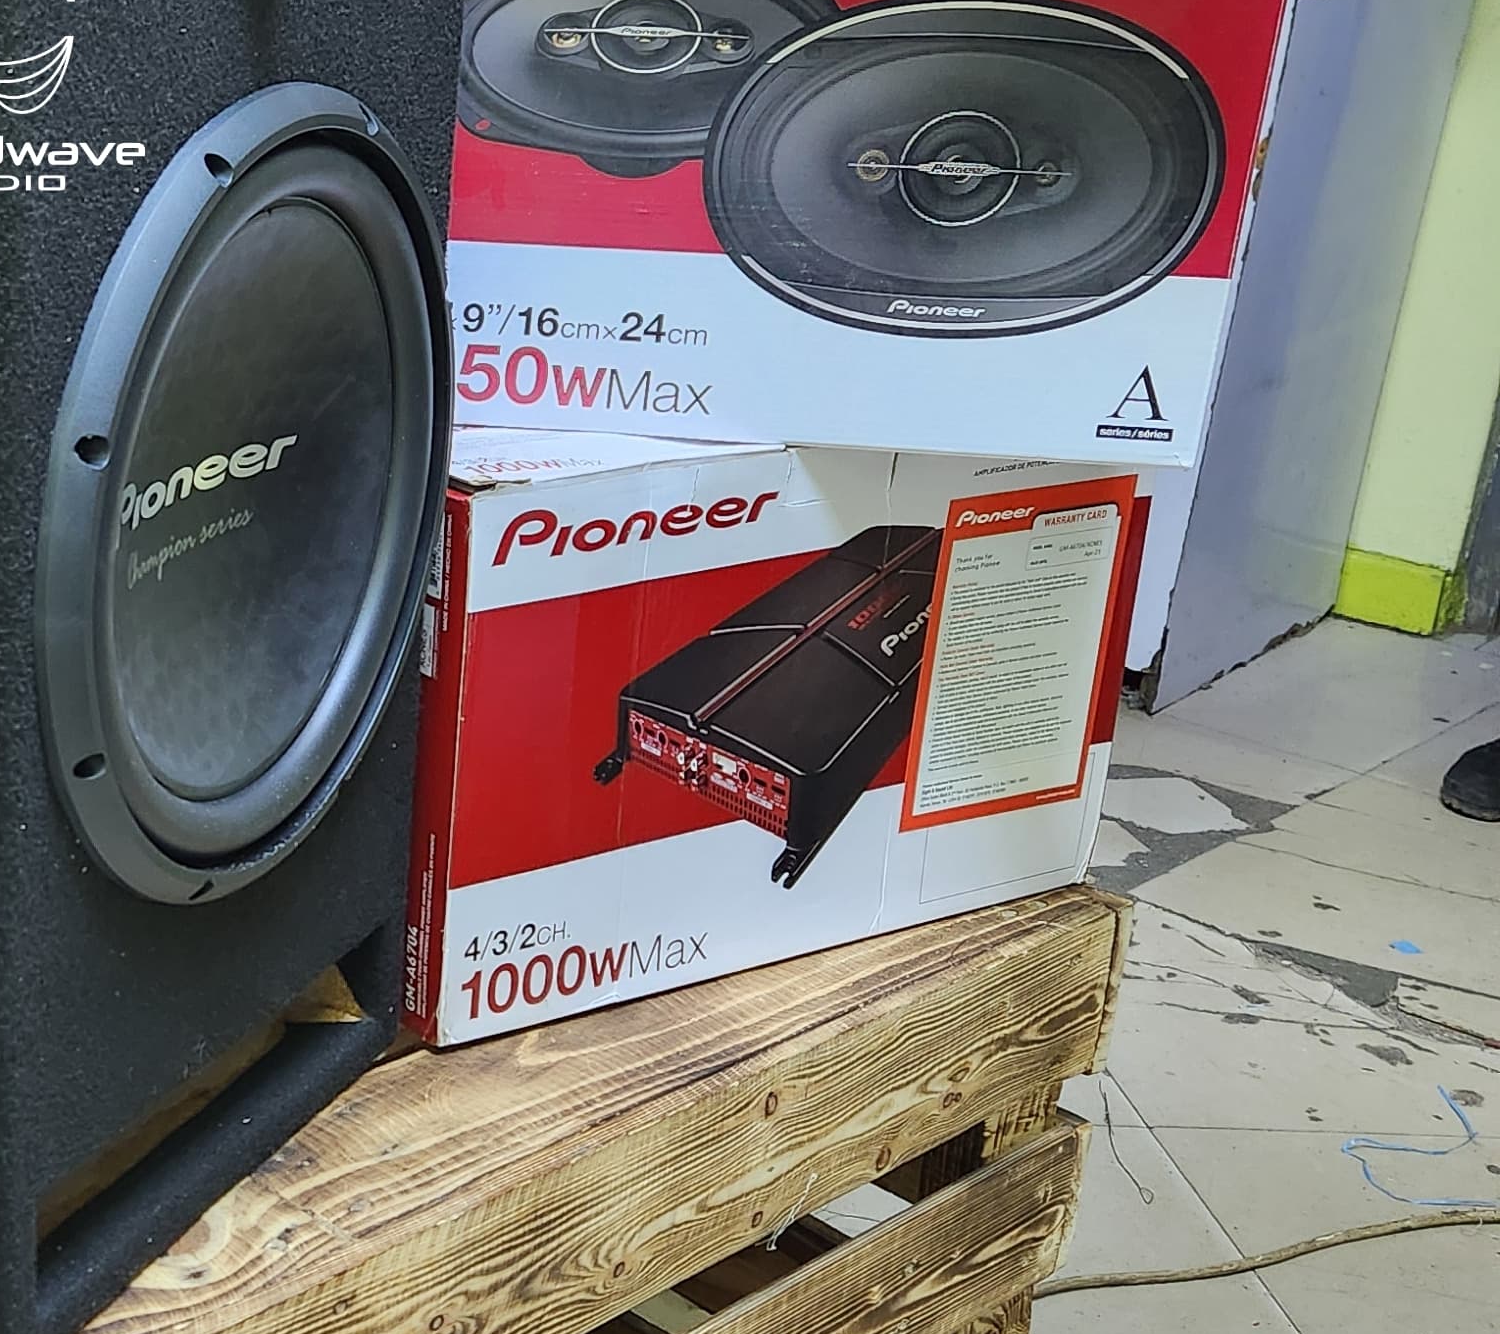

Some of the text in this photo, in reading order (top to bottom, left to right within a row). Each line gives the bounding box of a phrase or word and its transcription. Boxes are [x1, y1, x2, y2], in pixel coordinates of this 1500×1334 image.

[931, 162, 989, 175] Pioneer
[887, 299, 986, 318] Pioneer
[1105, 364, 1170, 422] A
[955, 506, 1036, 528] Pioneer
[1043, 509, 1108, 528] WARRANTY CARD
[491, 491, 780, 567] Pioneer
[404, 924, 419, 1013] GM-A6704
